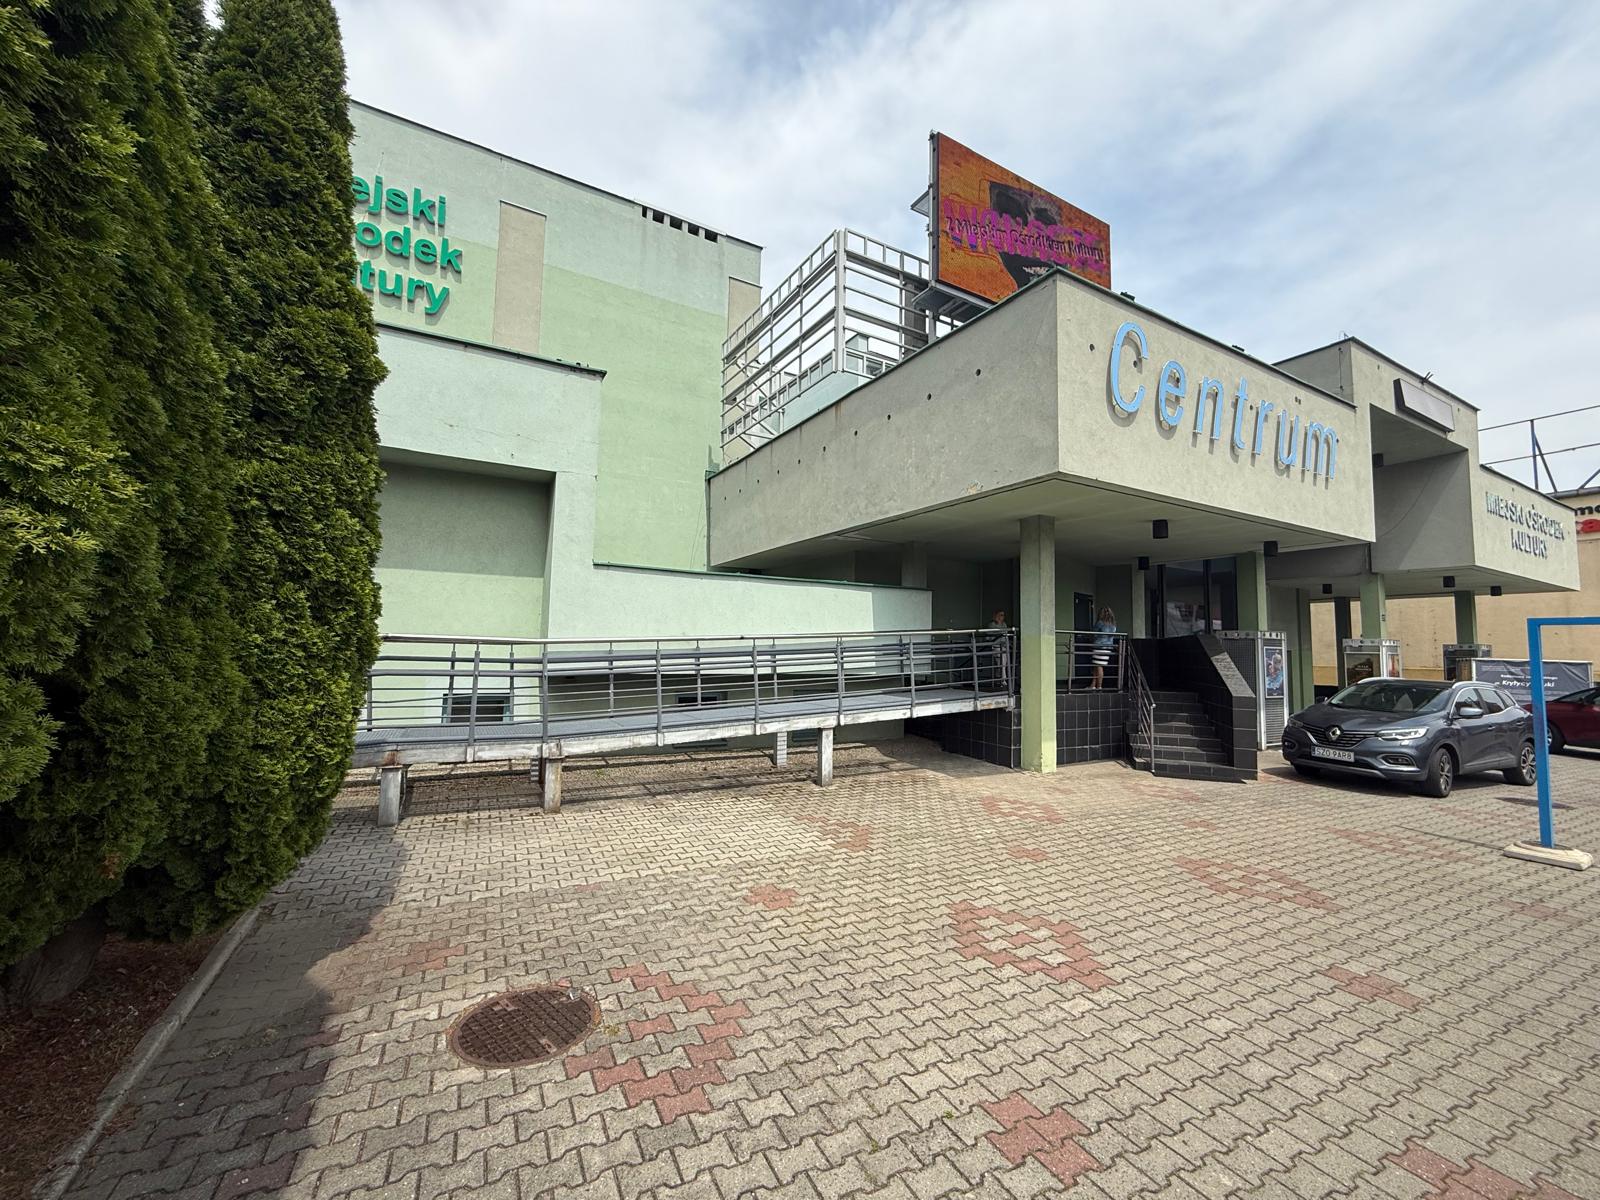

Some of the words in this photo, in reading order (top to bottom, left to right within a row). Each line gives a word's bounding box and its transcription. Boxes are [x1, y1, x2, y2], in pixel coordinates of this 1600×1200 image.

[352, 175, 446, 226] ejski
[356, 222, 462, 273] odek
[356, 259, 450, 314] tury
[1111, 321, 1338, 480] Centrum
